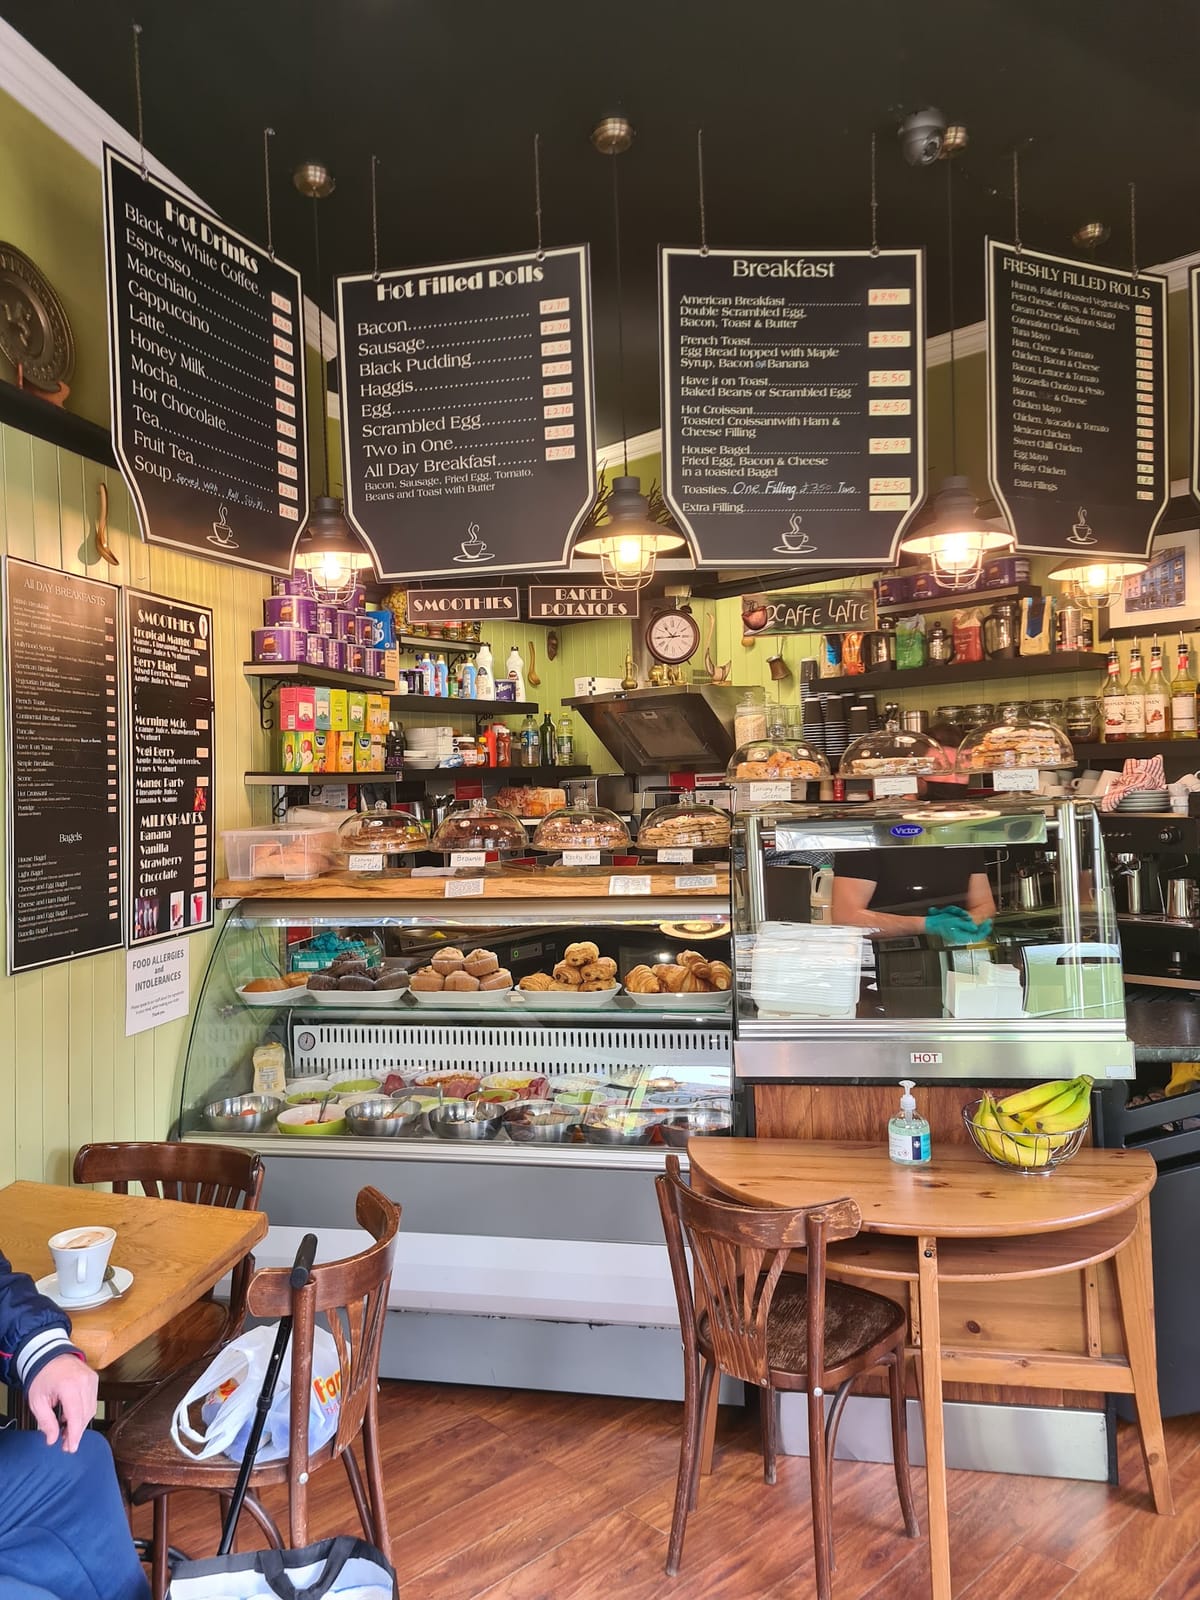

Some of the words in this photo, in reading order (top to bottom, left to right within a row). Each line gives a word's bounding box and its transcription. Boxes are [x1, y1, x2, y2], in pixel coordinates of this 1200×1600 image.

[165, 200, 198, 237] Hot
[201, 222, 258, 275] Drinks
[125, 202, 164, 240] Black
[168, 234, 178, 247] or
[181, 236, 218, 271] White
[220, 262, 258, 295] Coffee
[126, 228, 191, 278] Espresso
[732, 259, 835, 278] Breakfast
[127, 253, 198, 304] Macchiato
[376, 282, 415, 302] Hot
[418, 272, 483, 296] Filled
[488, 265, 544, 288] Rolls
[1003, 257, 1060, 282] FRESHLY
[1063, 272, 1106, 290] FILLED
[1109, 280, 1152, 300] ROLLS
[128, 280, 210, 334] Cappuccino
[680, 295, 732, 306] American
[734, 296, 784, 306] Breakfast
[130, 304, 165, 334] Latte
[680, 306, 718, 316] Double
[722, 307, 780, 317] Scrambled
[358, 320, 408, 336] Bacon
[721, 318, 751, 328] Toast
[754, 319, 762, 328] &
[765, 318, 798, 328] Butter
[358, 338, 425, 357] Sausage
[680, 336, 718, 345] French
[720, 336, 750, 346] Toast
[130, 328, 176, 366] Honey
[180, 352, 206, 378] Milk
[680, 347, 702, 358] Egg
[704, 346, 737, 356] Bread
[740, 348, 778, 359] topped
[780, 348, 804, 357] with
[806, 348, 840, 360] Maple
[360, 361, 402, 376] Black
[406, 352, 472, 372] Pudding
[718, 358, 754, 368] Bacon
[768, 359, 809, 368] Banana
[131, 354, 178, 389] Mocha
[680, 376, 709, 385] Have
[712, 376, 718, 386] it
[721, 378, 736, 386] on
[738, 376, 768, 386] Toast
[360, 380, 414, 398] Haggis
[681, 387, 715, 396] Baked
[718, 387, 752, 397] Beans
[768, 388, 827, 398] Scrambled
[830, 388, 852, 398] Egg
[132, 380, 157, 403] Hot
[161, 392, 227, 431] Chocolate
[361, 402, 392, 419] Egg
[681, 404, 700, 414] Hot
[702, 405, 754, 415] Croissant
[1042, 404, 1062, 414] Mayo
[132, 404, 160, 429] Tea
[681, 416, 724, 426] Toasted
[802, 416, 829, 426] Ham
[832, 417, 840, 426] &
[362, 418, 445, 438] Scrambled
[450, 414, 481, 431] Egg
[681, 428, 722, 437] Cheese
[725, 428, 757, 438] Filling
[134, 429, 166, 454] Fruit
[168, 442, 194, 464] Tea
[362, 443, 398, 458] Two
[402, 440, 416, 454] in
[420, 438, 454, 452] One
[681, 446, 718, 455] House
[720, 446, 750, 457] Bagel
[364, 464, 383, 478] All
[388, 462, 419, 477] Day
[424, 454, 496, 474] Breakfast
[682, 456, 709, 466] Fried
[740, 456, 774, 466] Bacon
[776, 456, 784, 466] &
[788, 456, 828, 466] Cheese
[134, 455, 172, 483] Soup
[682, 468, 692, 476] in
[704, 468, 745, 477] toasted
[747, 468, 778, 479] Bagel
[444, 472, 468, 483] Fried
[366, 490, 394, 502] Beans
[396, 488, 414, 498] and
[416, 487, 442, 497] Toast
[444, 484, 465, 495] with
[467, 482, 496, 493] Butter
[682, 485, 726, 495] Toasties
[732, 482, 760, 494] One
[764, 480, 797, 500] Filling
[682, 503, 710, 512] Extra
[712, 503, 744, 514] Filling
[24, 578, 34, 590] All
[36, 580, 54, 593] DAY
[56, 587, 106, 607] BREAKFASTS
[555, 588, 613, 602] BAKED
[413, 596, 513, 612] SMOOTHIES
[541, 602, 628, 616] POTATOES
[829, 598, 870, 622] LATTE
[138, 609, 195, 634] SMOOTHIES
[133, 626, 166, 642] Tropical
[166, 634, 192, 648] Mango
[134, 656, 156, 668] Berry
[135, 716, 168, 728] Morning
[170, 718, 187, 728] Mojo
[136, 746, 152, 757] Yogi
[154, 748, 175, 758] Berry
[136, 779, 162, 788] Mango
[164, 778, 185, 788] Party
[140, 812, 204, 828] MILKSHAKES
[59, 832, 82, 844] Bagels
[140, 830, 172, 841] Banana
[895, 826, 919, 836] Victor
[140, 843, 169, 855] Vanilla
[140, 856, 182, 870] Strawberry
[140, 869, 178, 884] Chocolate
[140, 887, 158, 898] Oreo
[132, 958, 151, 970] FOOD
[152, 949, 184, 965] ALLERGIES
[154, 965, 164, 974] and
[134, 970, 182, 992] INTOLERANCES
[913, 1053, 938, 1063] HOT
